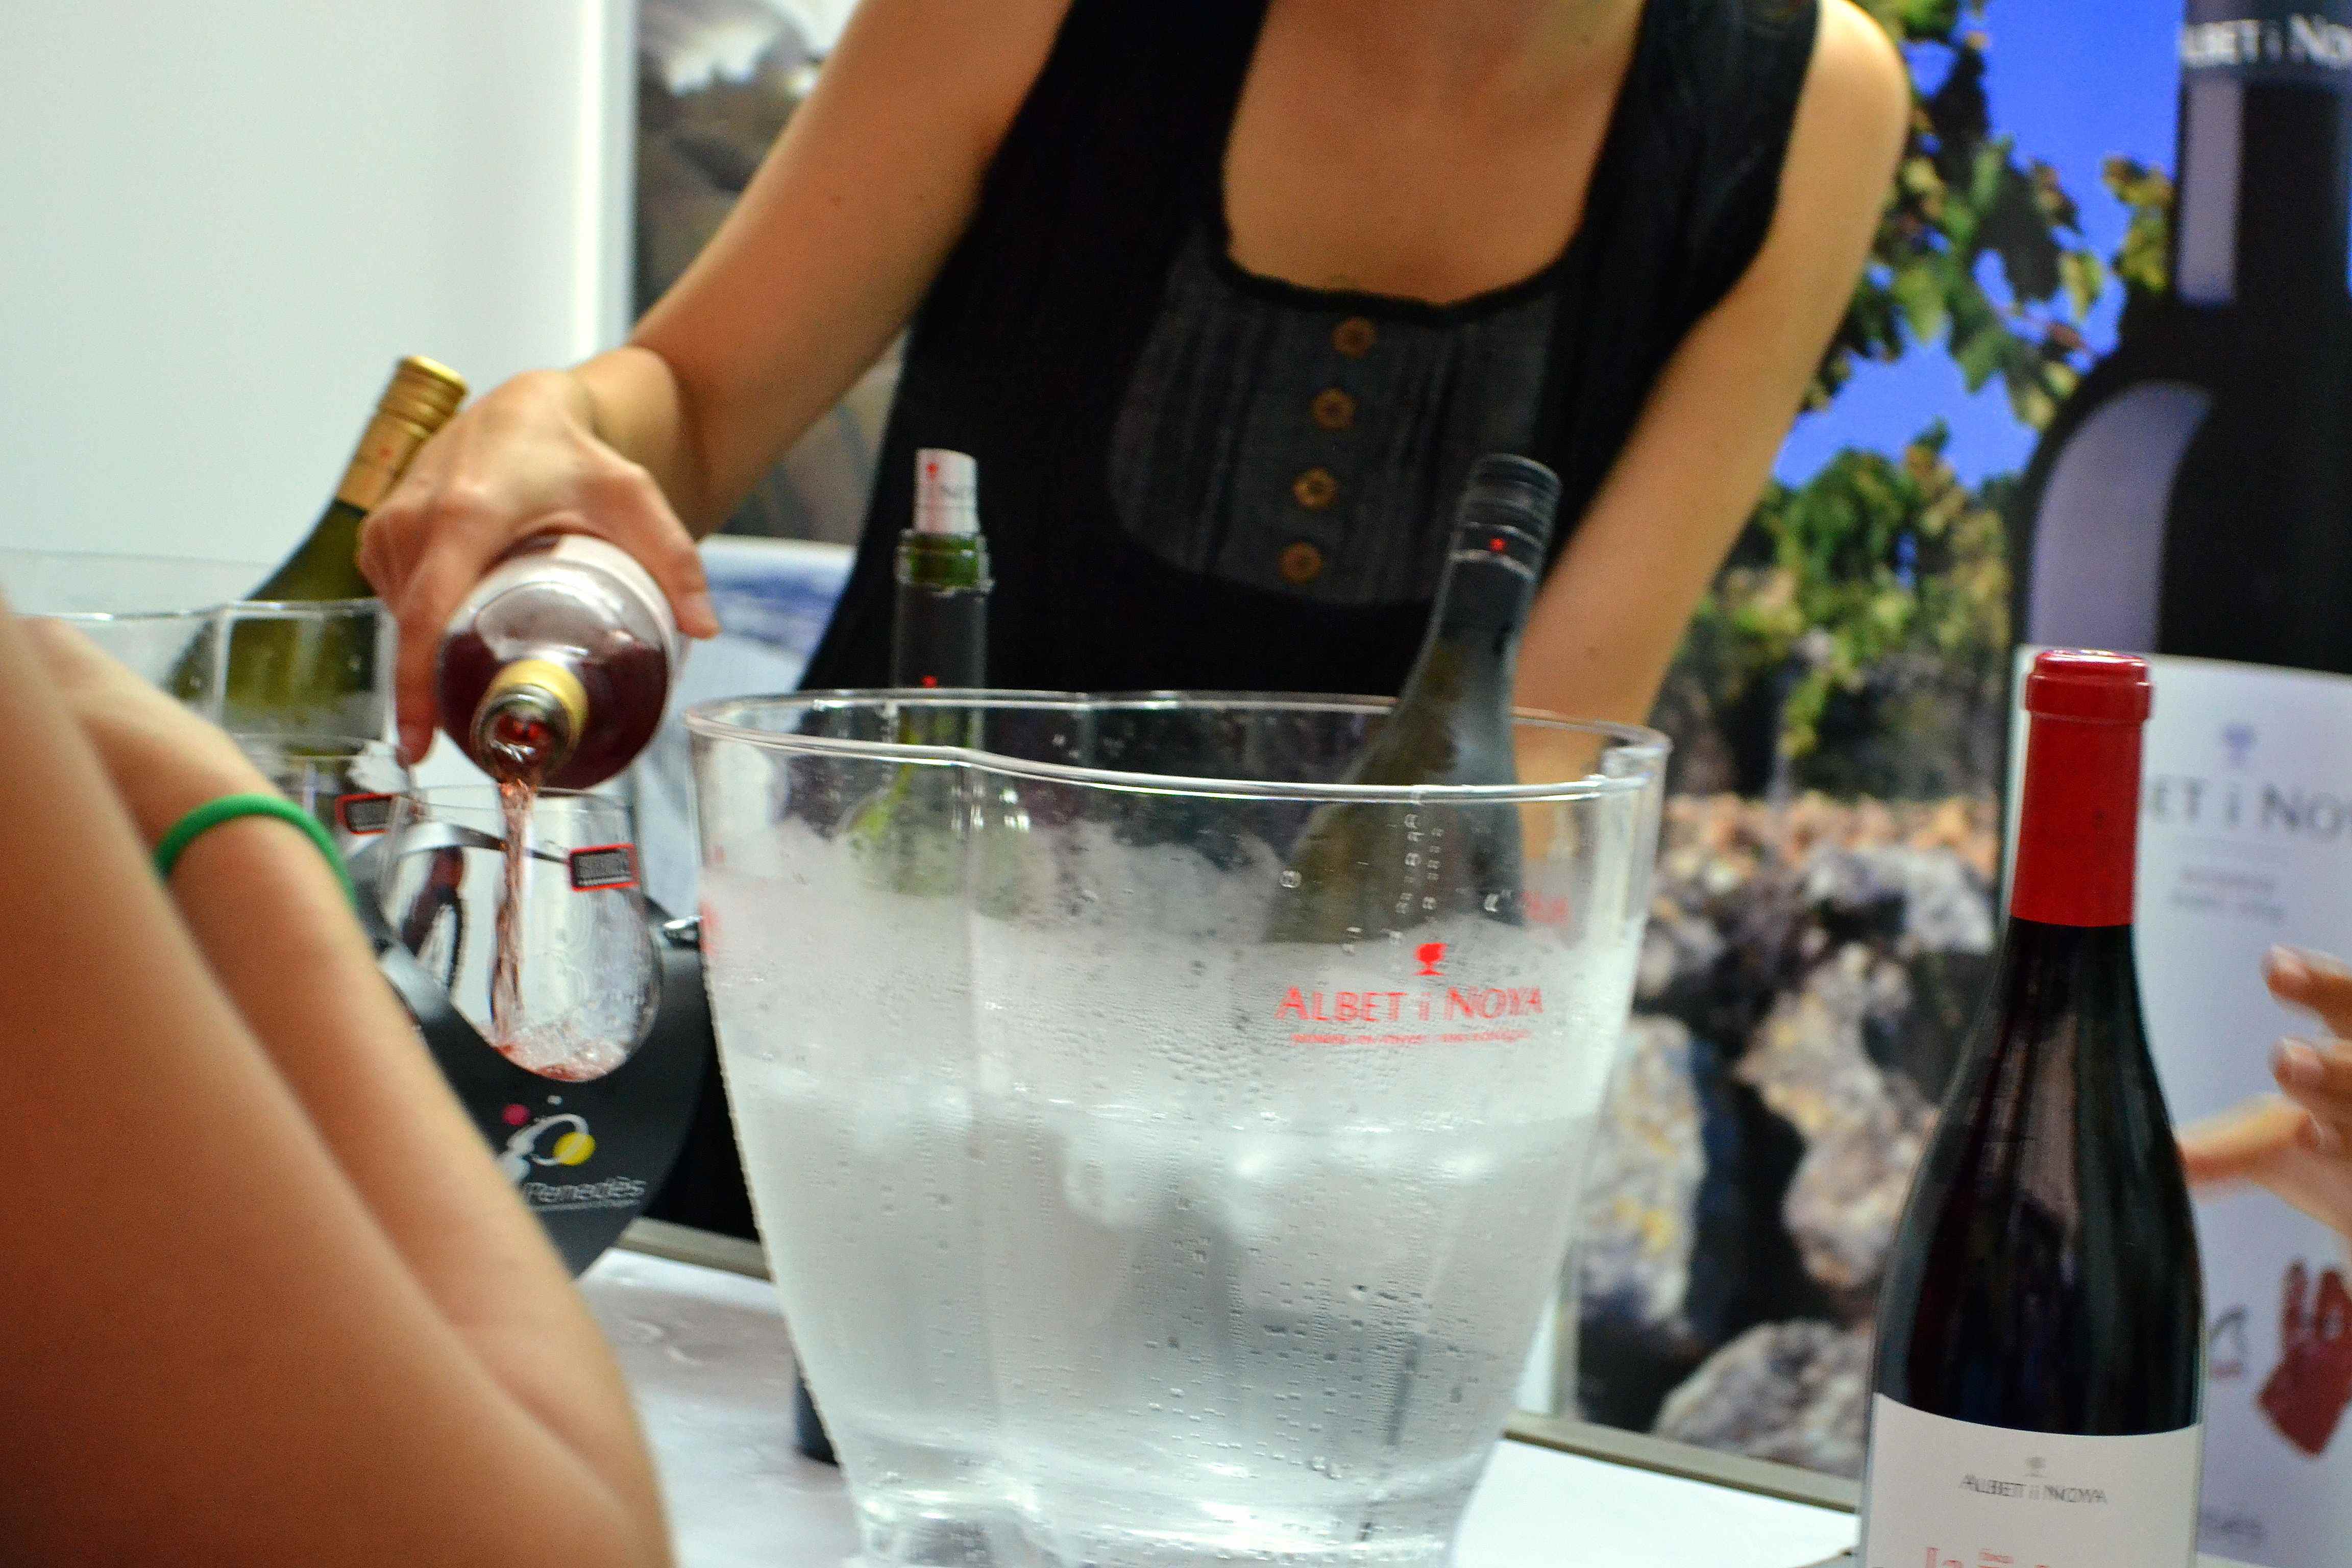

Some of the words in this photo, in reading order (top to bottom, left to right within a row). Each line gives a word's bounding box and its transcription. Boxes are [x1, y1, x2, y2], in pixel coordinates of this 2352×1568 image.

[1275, 986, 1407, 1022] ALBET
[1417, 992, 1432, 1021] i
[1443, 985, 1543, 1021] NOYA
[1959, 1473, 2027, 1500] ALBET
[2043, 1484, 2108, 1505] NOYA
